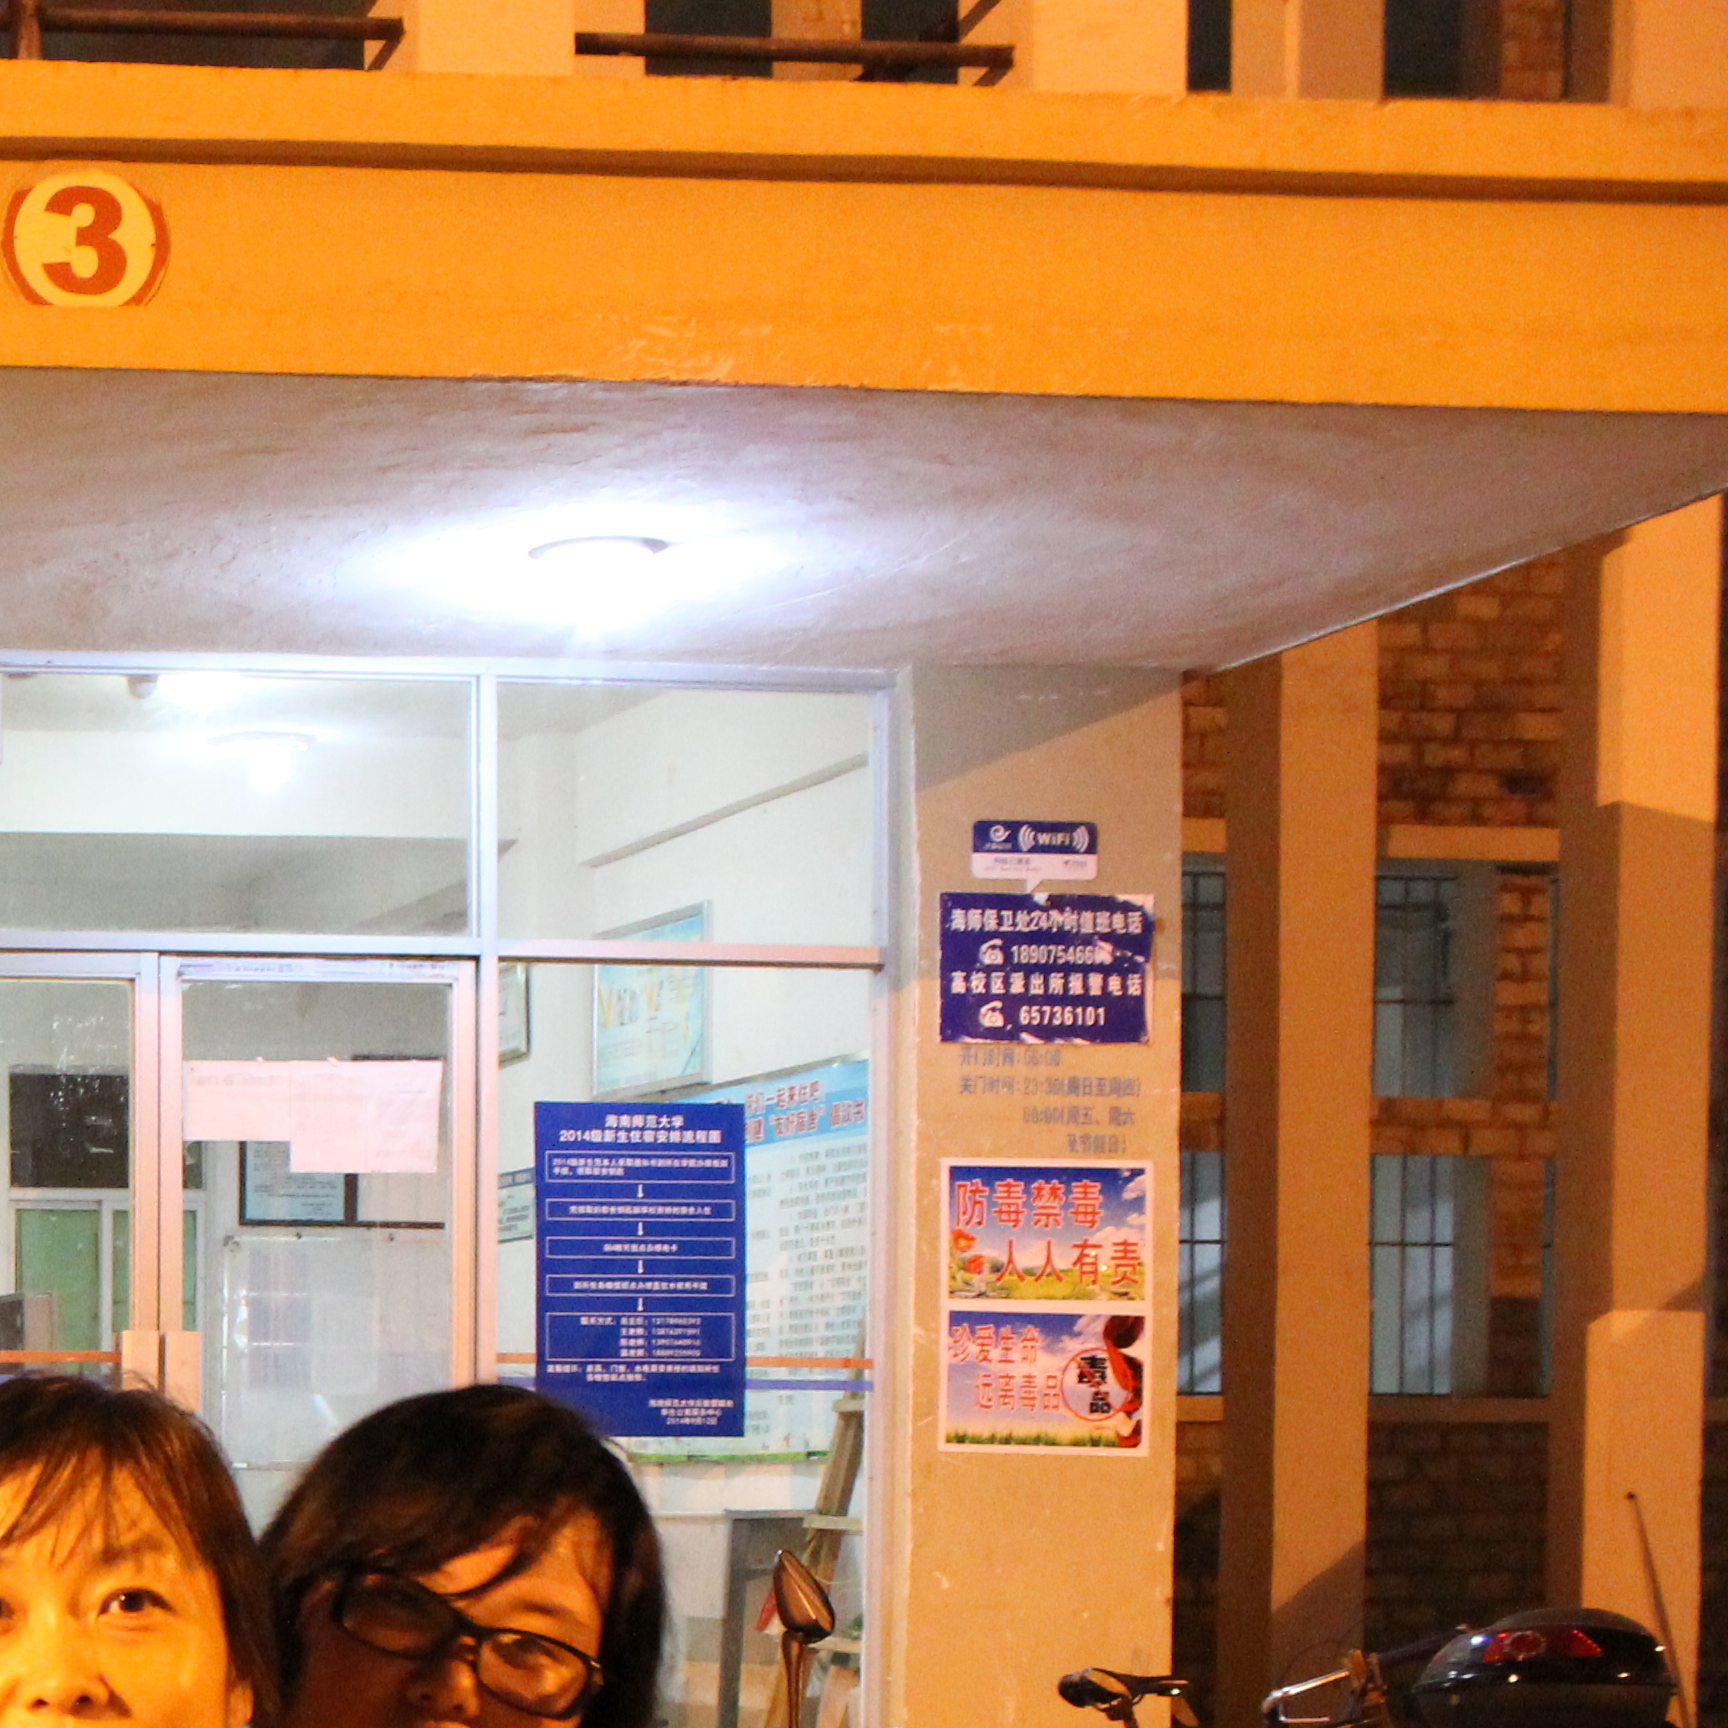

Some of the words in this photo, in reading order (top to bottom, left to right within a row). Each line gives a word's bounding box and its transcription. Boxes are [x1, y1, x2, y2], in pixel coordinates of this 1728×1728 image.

[41, 185, 128, 295] 3
[950, 971, 1143, 996] 高校区派出所报警电话
[1019, 1005, 1106, 1026] 65736101
[604, 1113, 685, 1129] 海南师范大学
[953, 1178, 1104, 1230] 防毒禁毒
[994, 1238, 1141, 1286] 人人有责
[948, 1322, 1040, 1364] 珍爱生命
[975, 1372, 1062, 1412] 远离毒品
